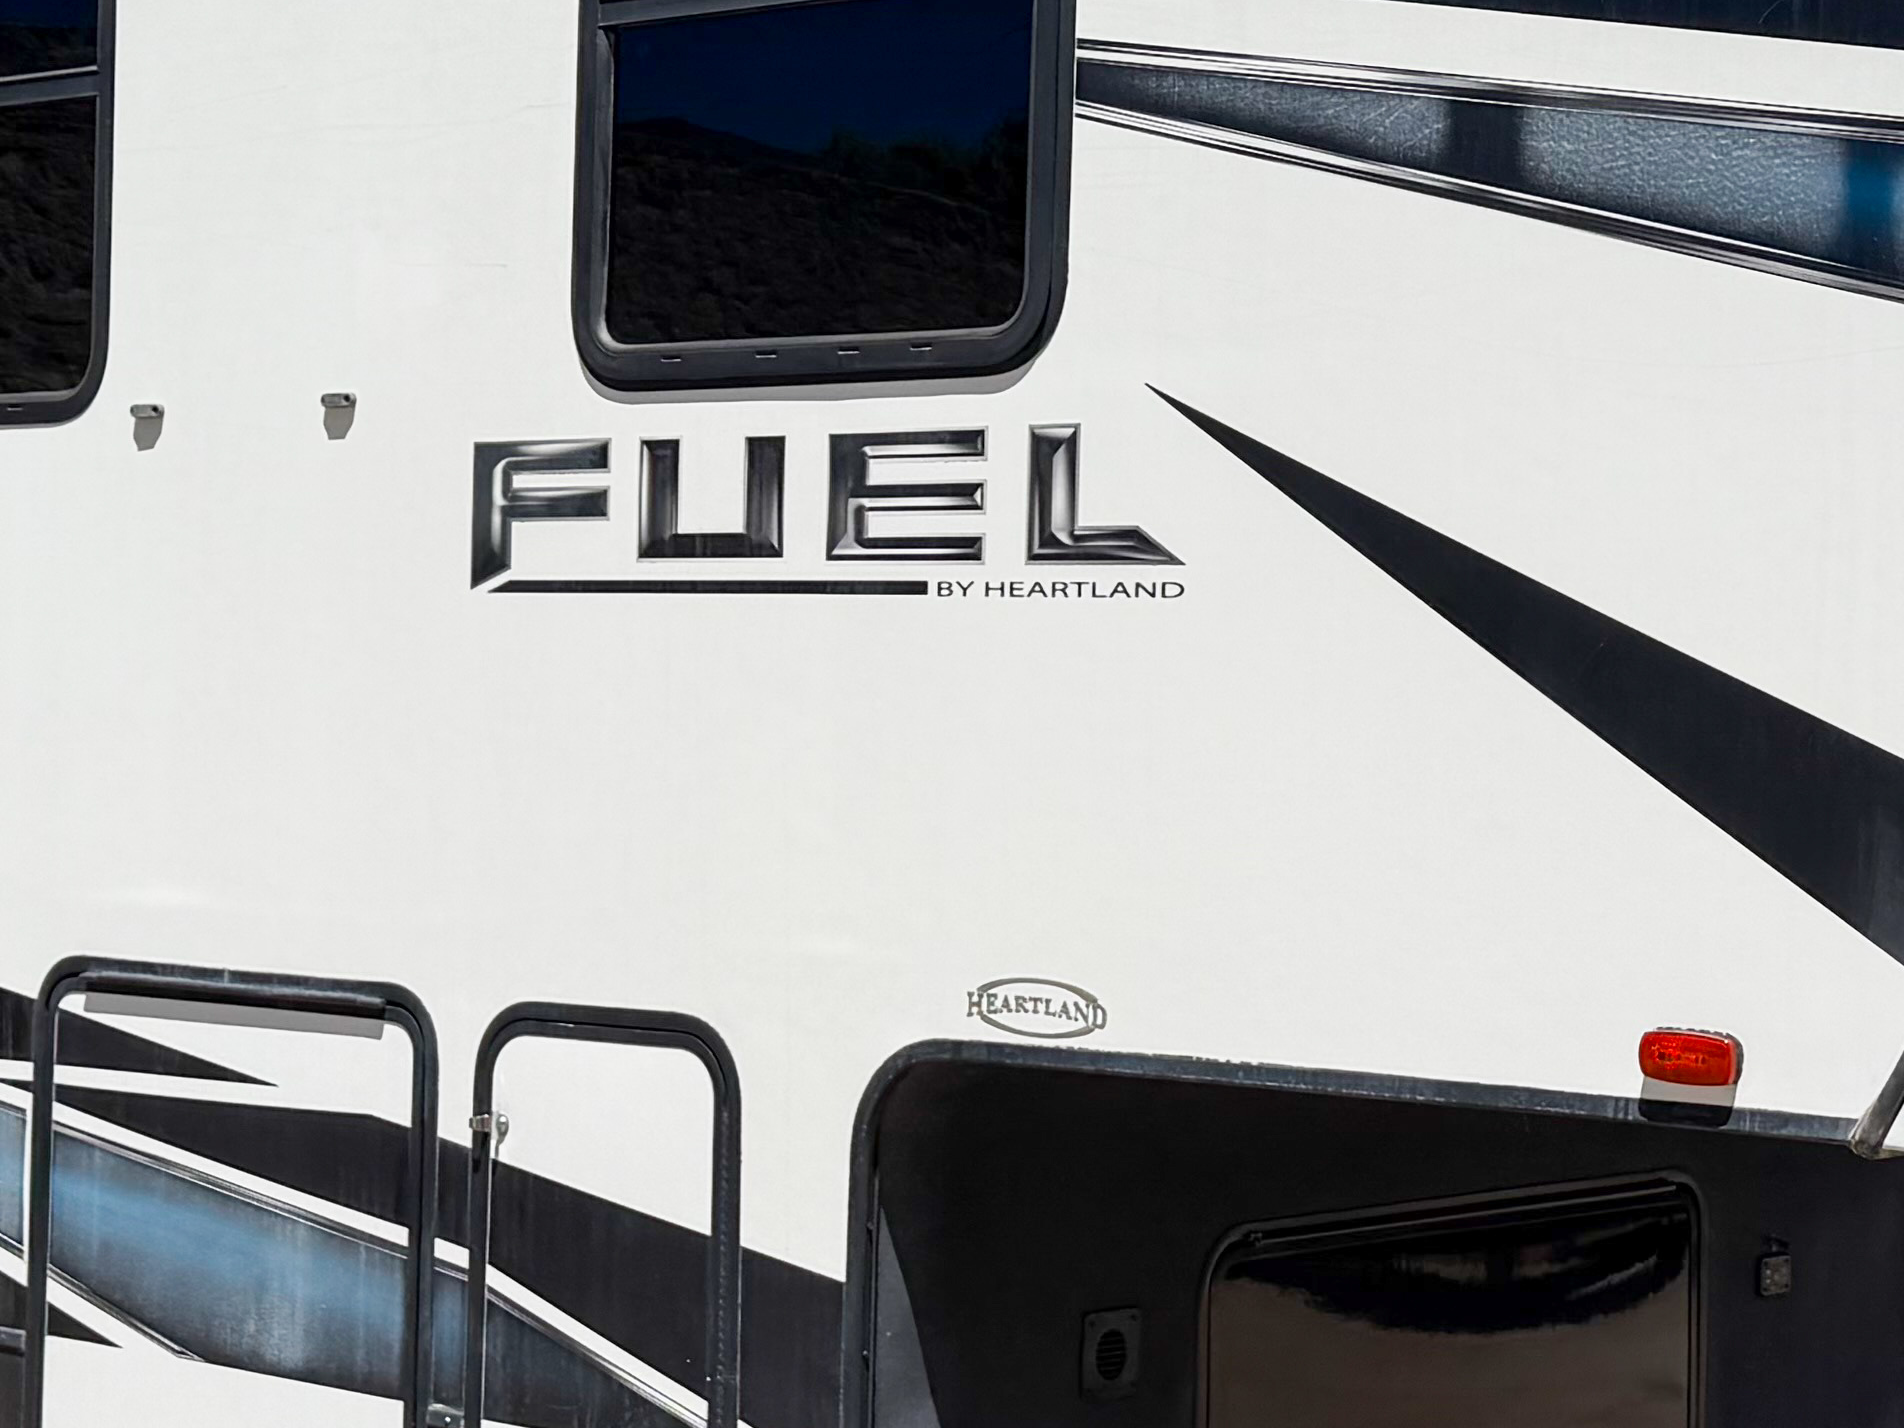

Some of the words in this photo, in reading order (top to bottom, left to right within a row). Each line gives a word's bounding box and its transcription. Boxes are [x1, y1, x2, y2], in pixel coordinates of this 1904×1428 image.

[470, 423, 1186, 590] FUEL
[936, 580, 974, 598] BY
[984, 580, 1185, 599] HEARTLAND
[966, 990, 1108, 1030] HEARTLAND
